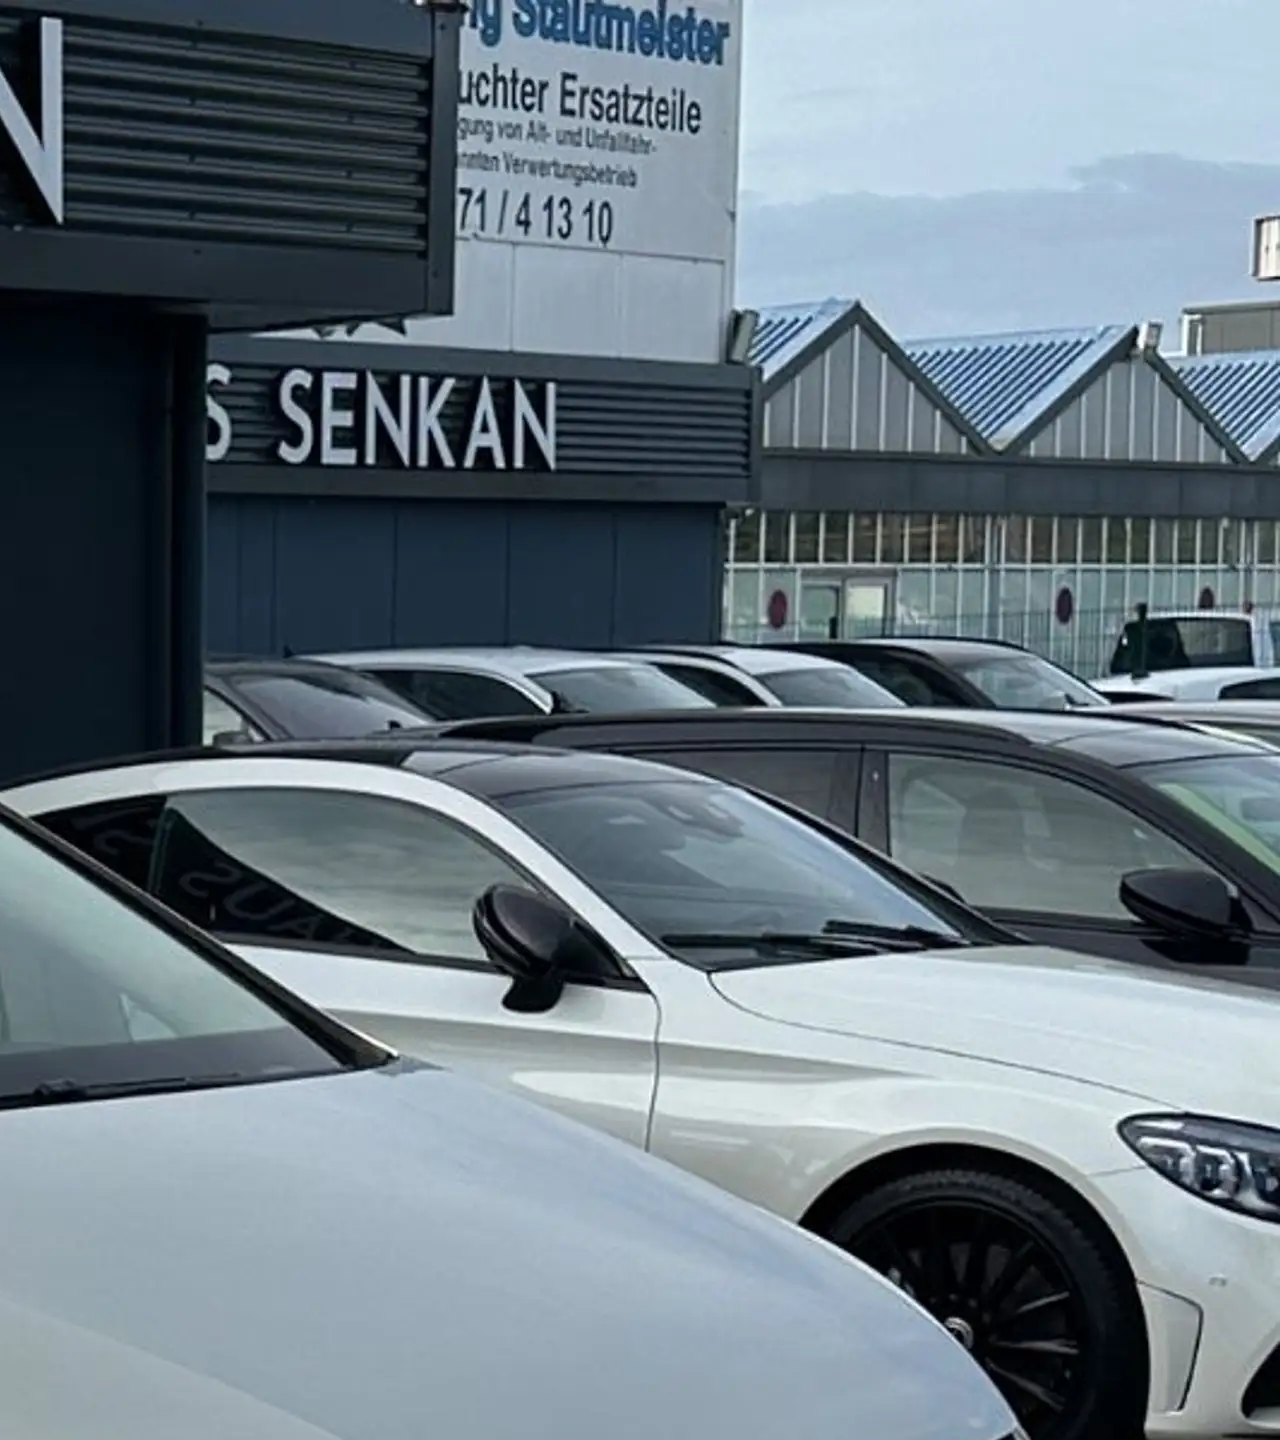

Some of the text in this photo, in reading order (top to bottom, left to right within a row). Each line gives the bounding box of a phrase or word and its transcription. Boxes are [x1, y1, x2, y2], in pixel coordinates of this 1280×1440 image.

[512, 0, 731, 66] Stautmeister
[496, 120, 523, 140] von
[559, 71, 702, 134] Ersatzteile
[515, 191, 532, 237] 4
[542, 194, 573, 240] 13
[582, 199, 614, 245] 10
[277, 367, 557, 471] SENKAN
